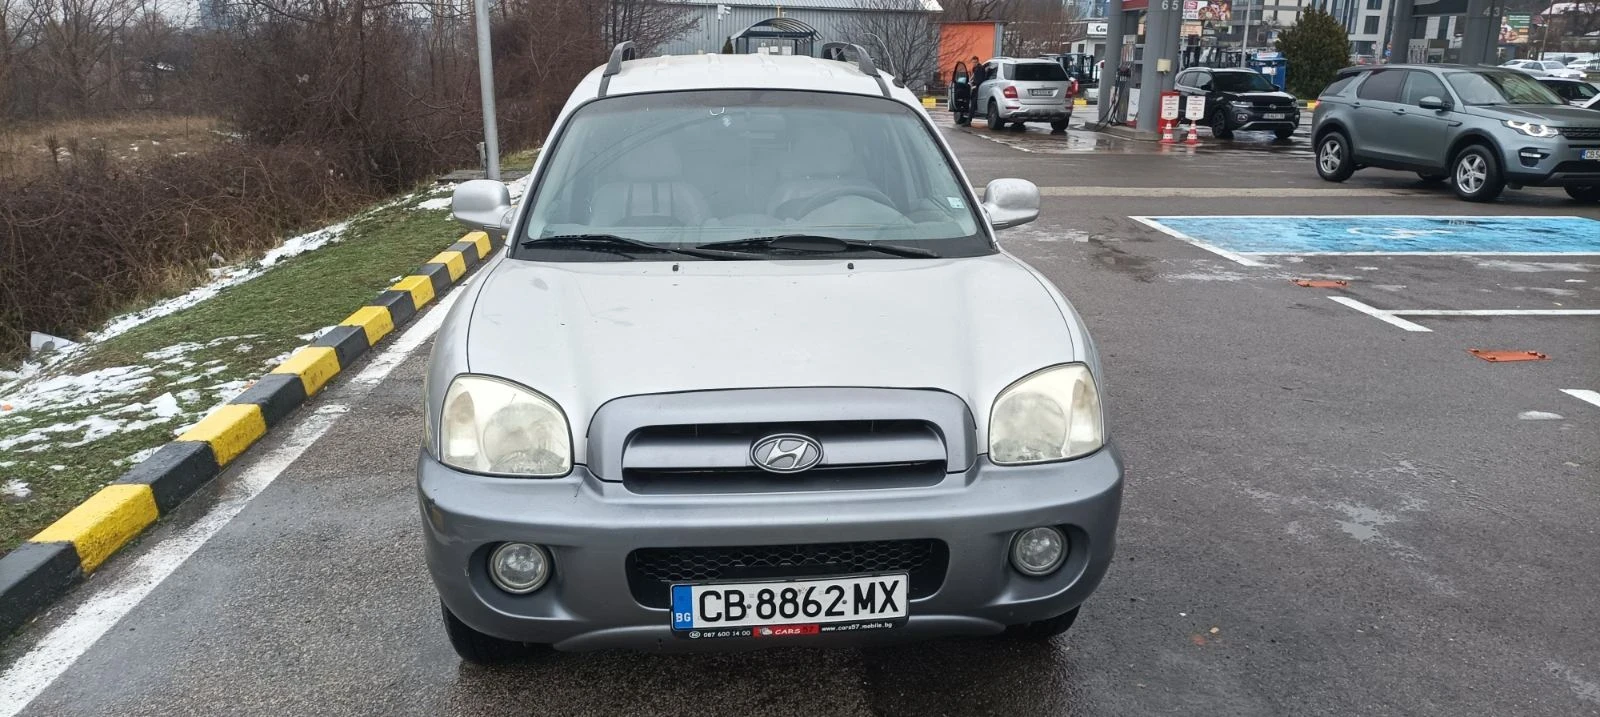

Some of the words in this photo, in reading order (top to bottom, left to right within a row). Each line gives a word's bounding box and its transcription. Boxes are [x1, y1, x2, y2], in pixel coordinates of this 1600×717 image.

[698, 590, 747, 622] CB
[756, 584, 845, 620] 8862
[853, 580, 900, 616] MX
[675, 612, 692, 623] BG
[741, 629, 751, 637] 00
[774, 627, 801, 636] CARS
[821, 622, 893, 633] www.cars57.mobile.bg
